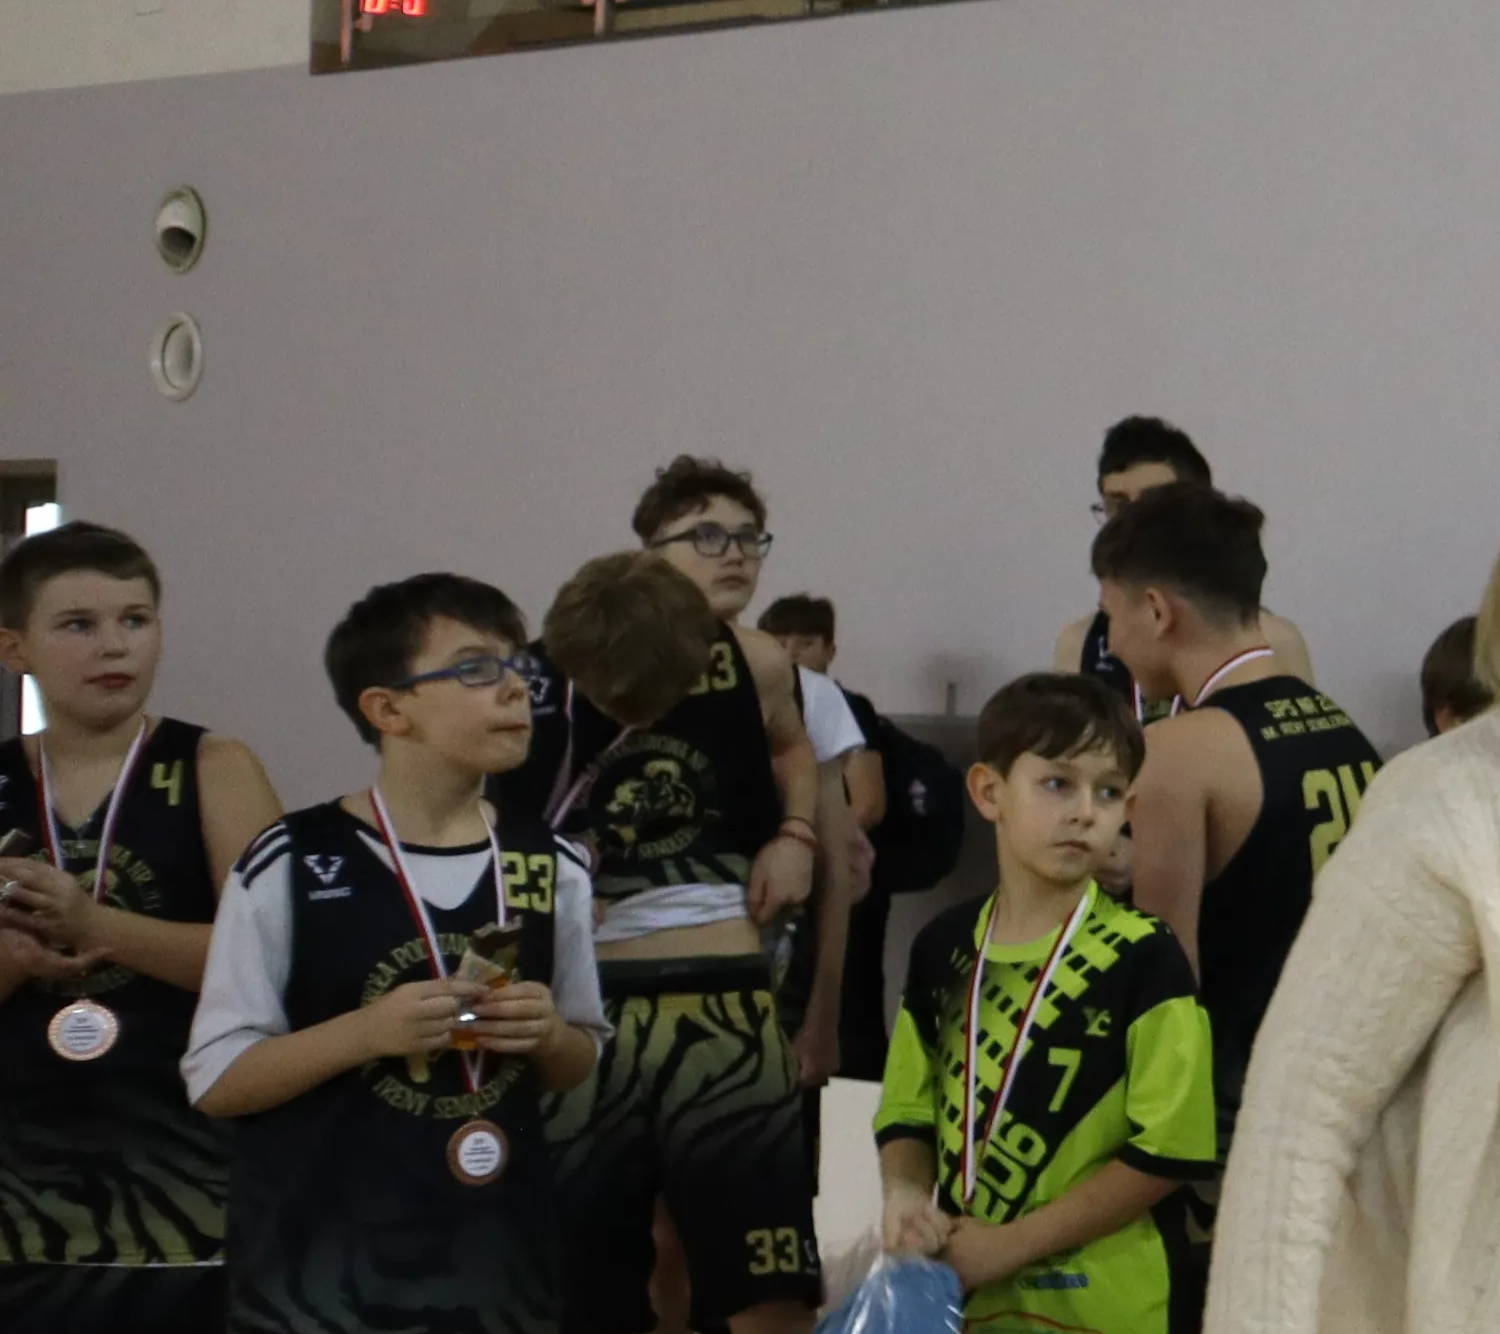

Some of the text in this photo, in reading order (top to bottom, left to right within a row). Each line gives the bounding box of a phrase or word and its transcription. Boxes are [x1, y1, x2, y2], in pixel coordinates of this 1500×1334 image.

[150, 758, 184, 807] 4
[501, 850, 555, 914] 23
[1047, 1047, 1082, 1114] 7
[744, 1226, 801, 1277] 33
